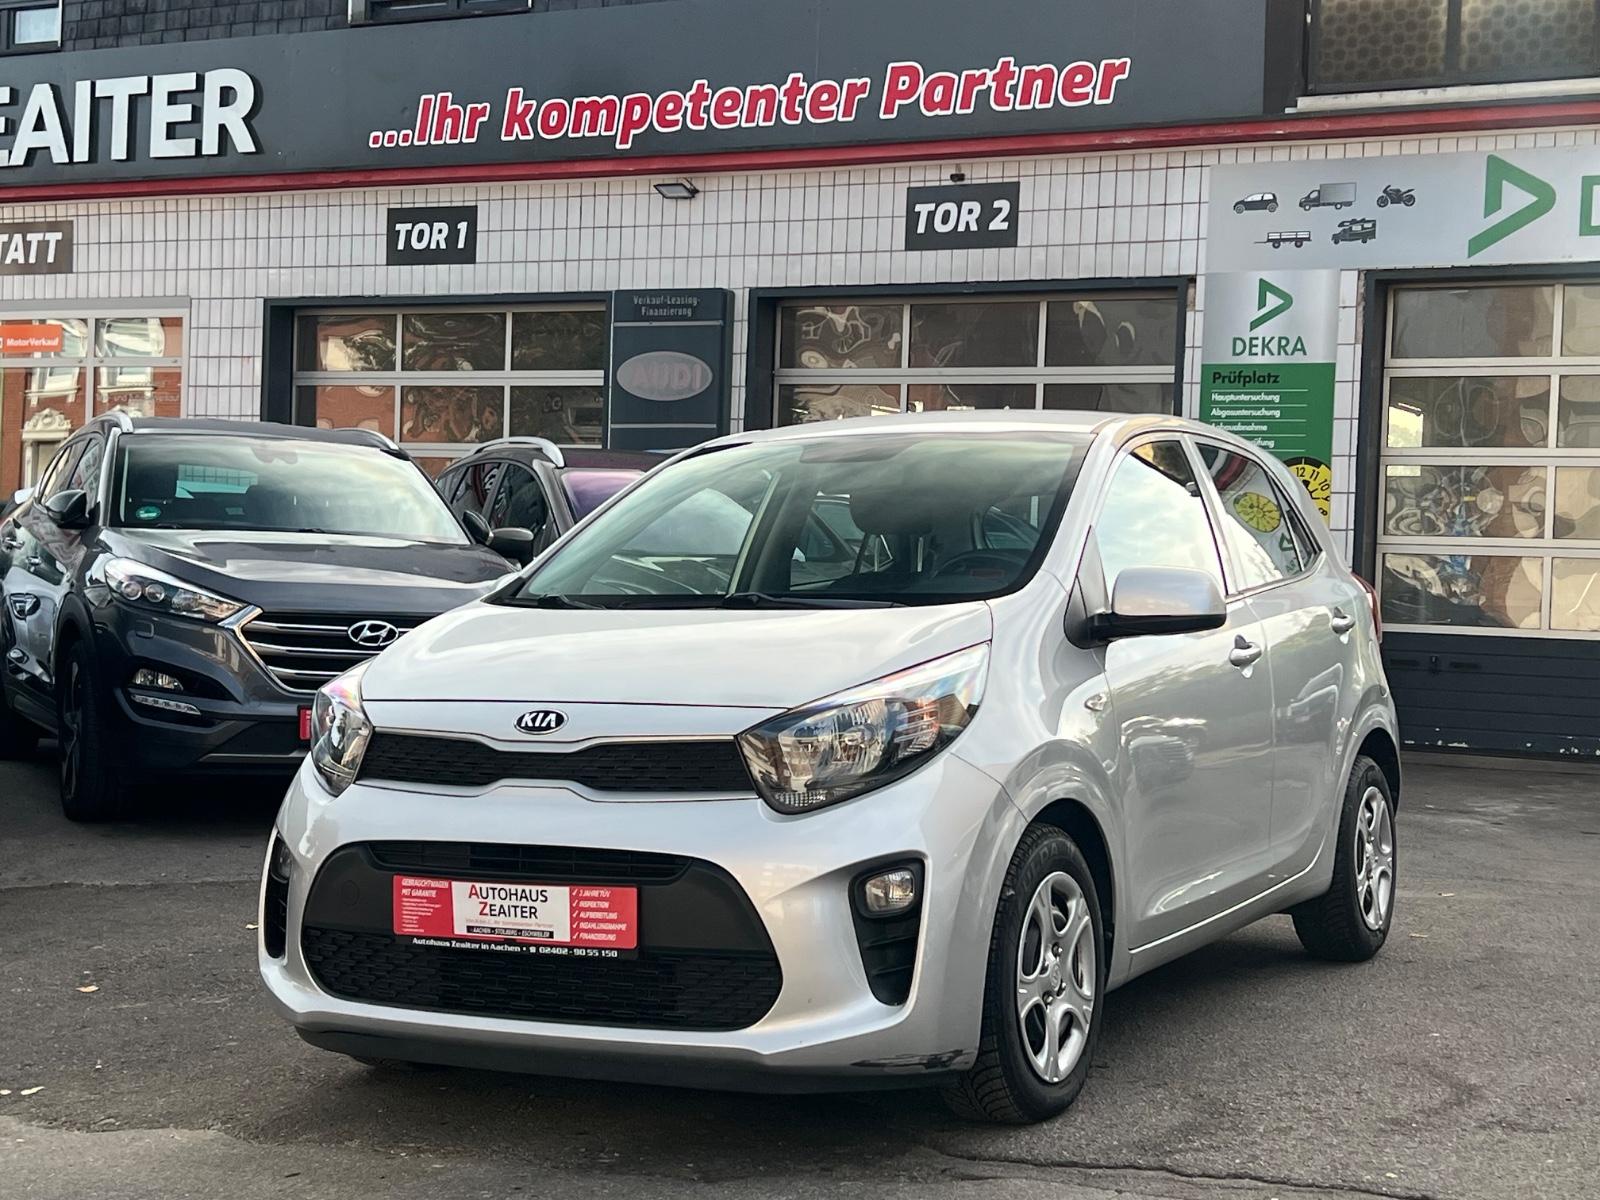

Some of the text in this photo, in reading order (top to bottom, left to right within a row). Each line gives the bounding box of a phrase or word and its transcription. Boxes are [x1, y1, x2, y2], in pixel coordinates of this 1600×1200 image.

[501, 72, 870, 150] kompetenter
[879, 56, 1131, 120] Partner
[0, 68, 256, 167] AITER
[914, 199, 1011, 234] TOR 2
[395, 221, 468, 250] TOR 1
[641, 306, 692, 317] Finanzierung
[1232, 335, 1307, 357] DEKRA
[1212, 370, 1280, 388] Prüfplatz
[1211, 392, 1280, 403] Hauptuntersuchung
[1210, 408, 1280, 418] Abgasuntersuchung
[1295, 466, 1306, 478] 12
[1309, 469, 1320, 481] 11
[1318, 478, 1331, 492] 10
[520, 712, 557, 728] KIA
[468, 884, 548, 903] AUTOHAUS
[479, 901, 538, 920] ZEAITER
[412, 937, 450, 947] Autohaus
[451, 940, 480, 950] Zeaiter
[481, 942, 489, 950] in
[490, 943, 520, 952] Aachen
[539, 946, 568, 955] 02402
[601, 949, 618, 958] 150
